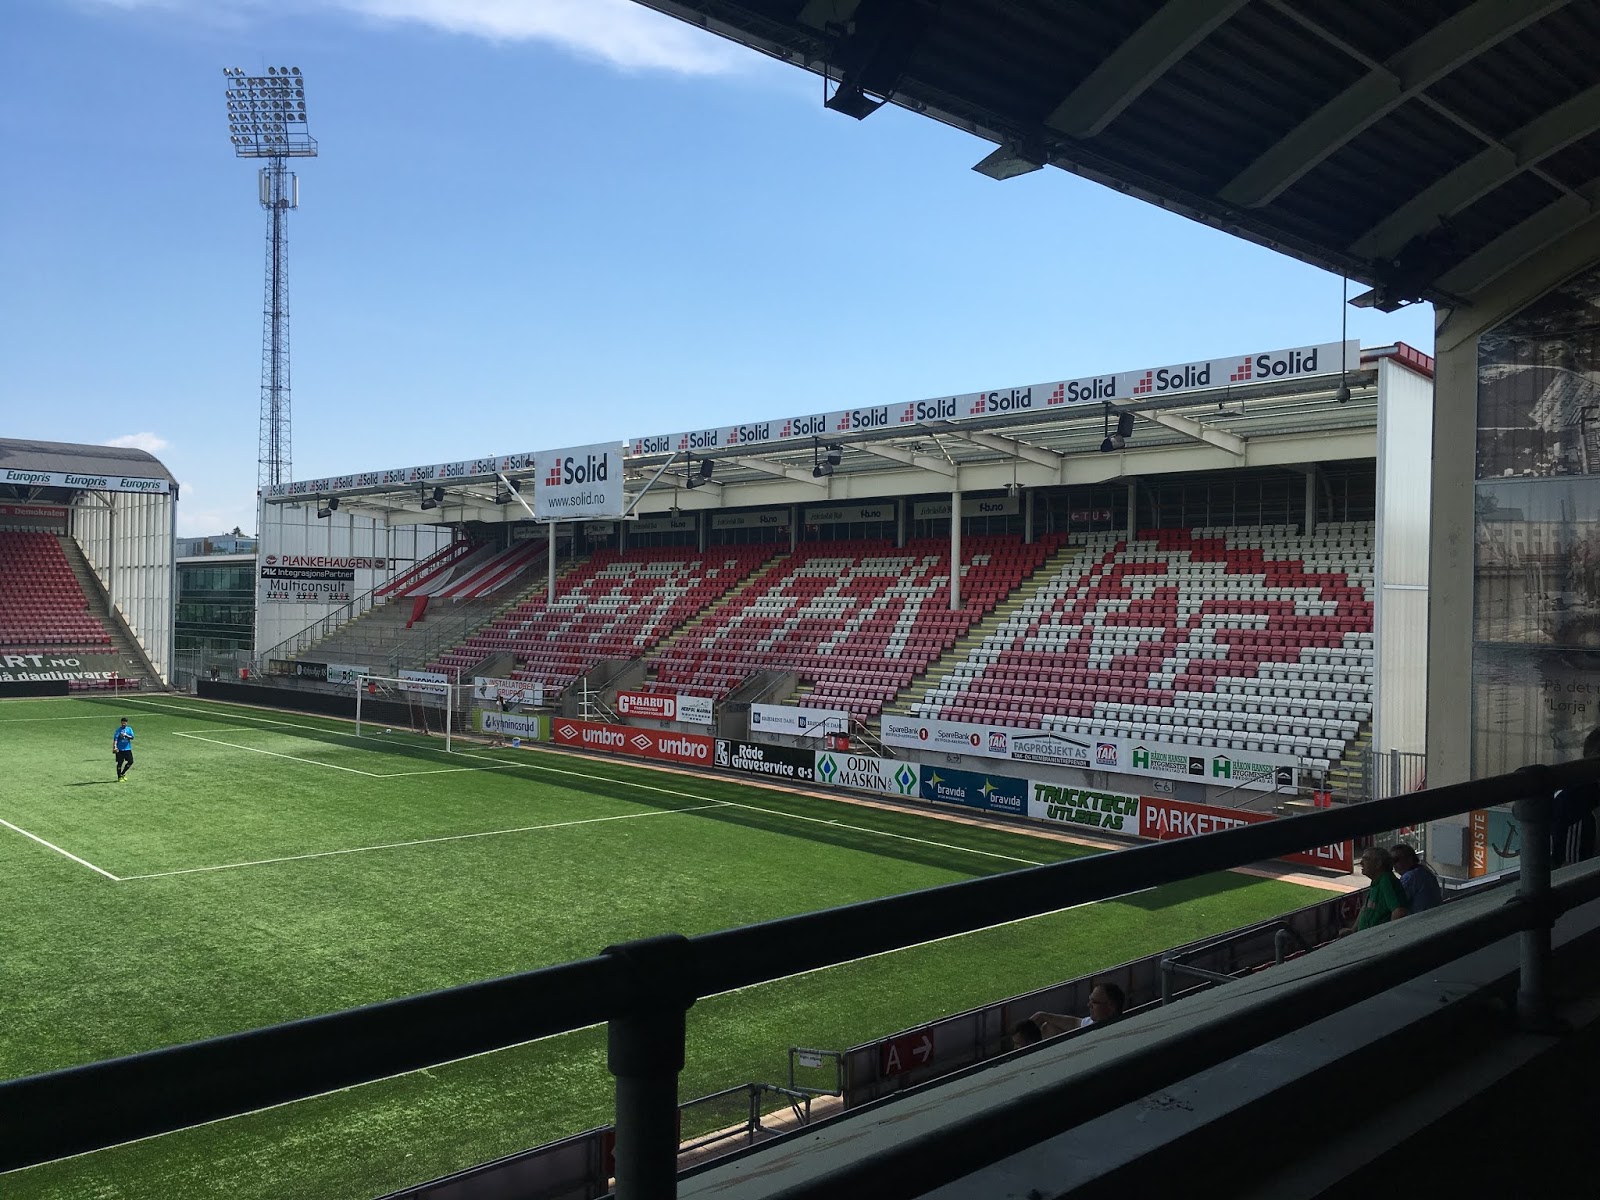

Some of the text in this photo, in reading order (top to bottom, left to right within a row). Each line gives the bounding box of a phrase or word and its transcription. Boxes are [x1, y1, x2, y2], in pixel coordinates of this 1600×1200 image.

[1256, 348, 1317, 378] Solid
[1157, 363, 1210, 390] Solid
[1068, 377, 1115, 402] Solid
[989, 388, 1031, 411] Solid
[917, 398, 956, 420] Solid
[794, 415, 825, 435] Solid
[853, 407, 887, 428] Solid
[690, 430, 717, 448] Solid
[740, 423, 769, 442] Solid
[644, 437, 669, 453] Solid
[447, 463, 464, 477] Solid
[478, 459, 495, 473] Solid
[511, 454, 530, 470] Solid
[564, 453, 607, 485] Solid
[6, 471, 51, 485] Europris
[65, 475, 108, 488] Europris
[363, 474, 378, 485] Solid
[390, 471, 405, 482] Solid
[417, 467, 434, 480] Solid
[120, 478, 161, 491] Europris
[316, 480, 329, 491] Solid
[339, 477, 353, 488] Solid
[549, 492, 605, 507] www.solid.no
[15, 508, 65, 516] Demokraten
[282, 556, 372, 569] PLANKEHAUGEN
[278, 568, 353, 578] IntegrasjonsPartner
[271, 579, 346, 592] Multiconsult
[0, 656, 80, 668] RT.NO
[1567, 679, 1591, 693] det
[619, 696, 675, 717] GRAARUD
[492, 715, 535, 733] kynningsrud
[889, 725, 919, 735] SpareBank
[582, 726, 625, 747] umbro
[938, 730, 970, 741] SpareBank
[658, 737, 708, 758] umbro
[739, 744, 763, 761] Råde
[1014, 741, 1073, 757] FAGPROSJEKT
[1075, 748, 1087, 758] AS
[732, 755, 795, 776] Graveservice
[847, 756, 880, 774] ODIN
[838, 770, 887, 790] MASKIN
[938, 784, 965, 798] bravida
[990, 792, 1021, 807] bravida
[1034, 783, 1139, 816] TRUCKTECH
[1047, 804, 1124, 830] UTLEIE AS
[1473, 813, 1485, 870] VÆRSTE
[886, 1044, 902, 1075] A
